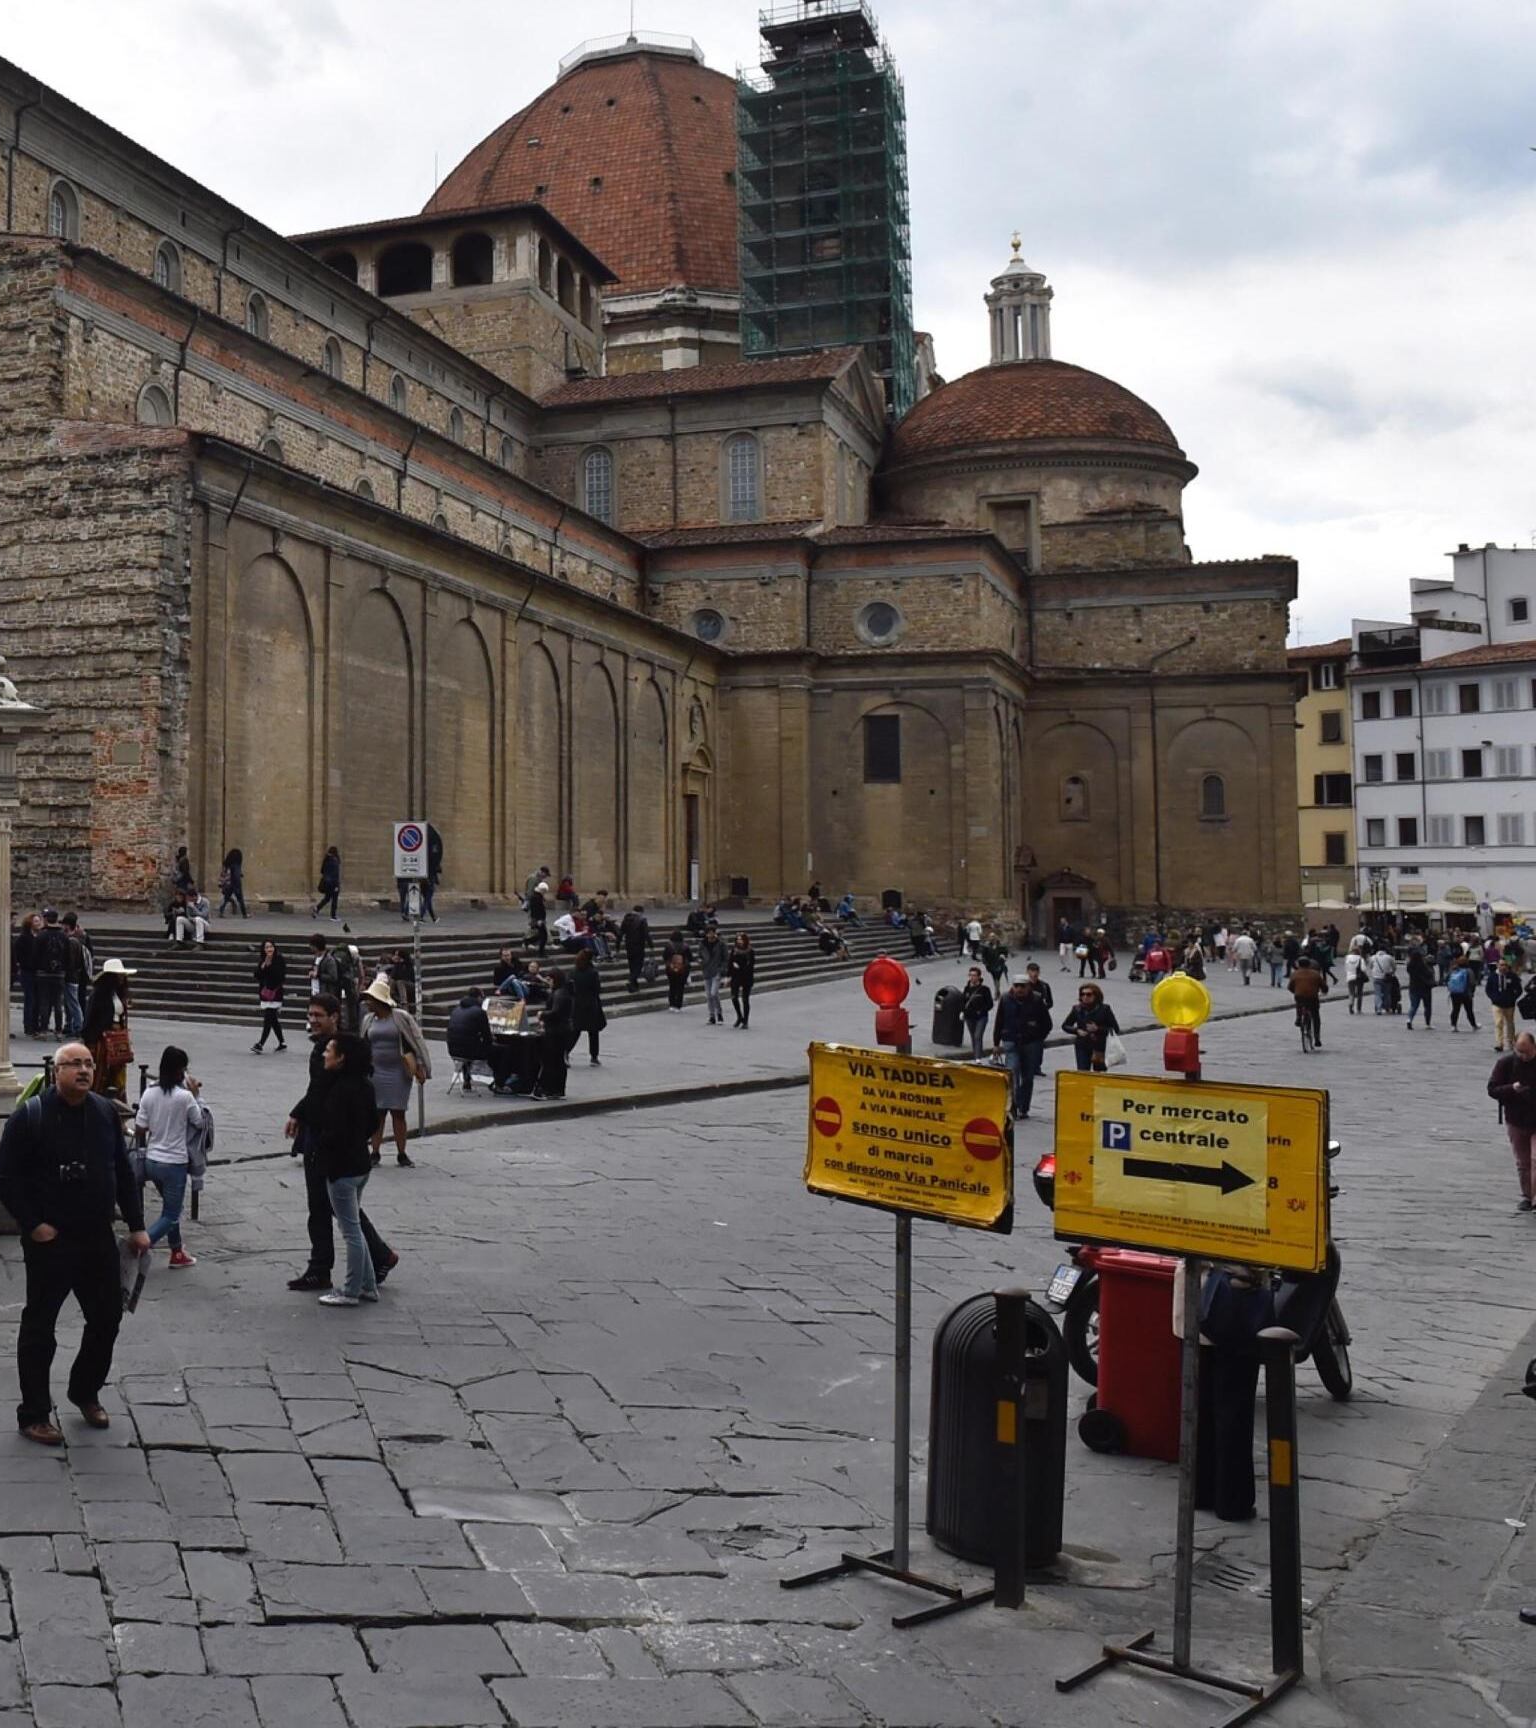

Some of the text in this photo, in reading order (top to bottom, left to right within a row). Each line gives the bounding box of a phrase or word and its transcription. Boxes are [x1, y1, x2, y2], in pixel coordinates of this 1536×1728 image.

[847, 1061, 956, 1088] VIA TADDEA
[862, 1086, 943, 1106] DA VIA ROSINA
[859, 1101, 946, 1122] A VIA PANICALE
[1122, 1099, 1250, 1125] Per mercato
[852, 1121, 952, 1147] senso unico
[1108, 1123, 1230, 1149] P centrale
[867, 1145, 934, 1166] di marcia
[824, 1158, 844, 1168] con
[846, 1160, 901, 1181] direzione
[904, 1170, 927, 1185] Via
[930, 1174, 991, 1195] Panicale
